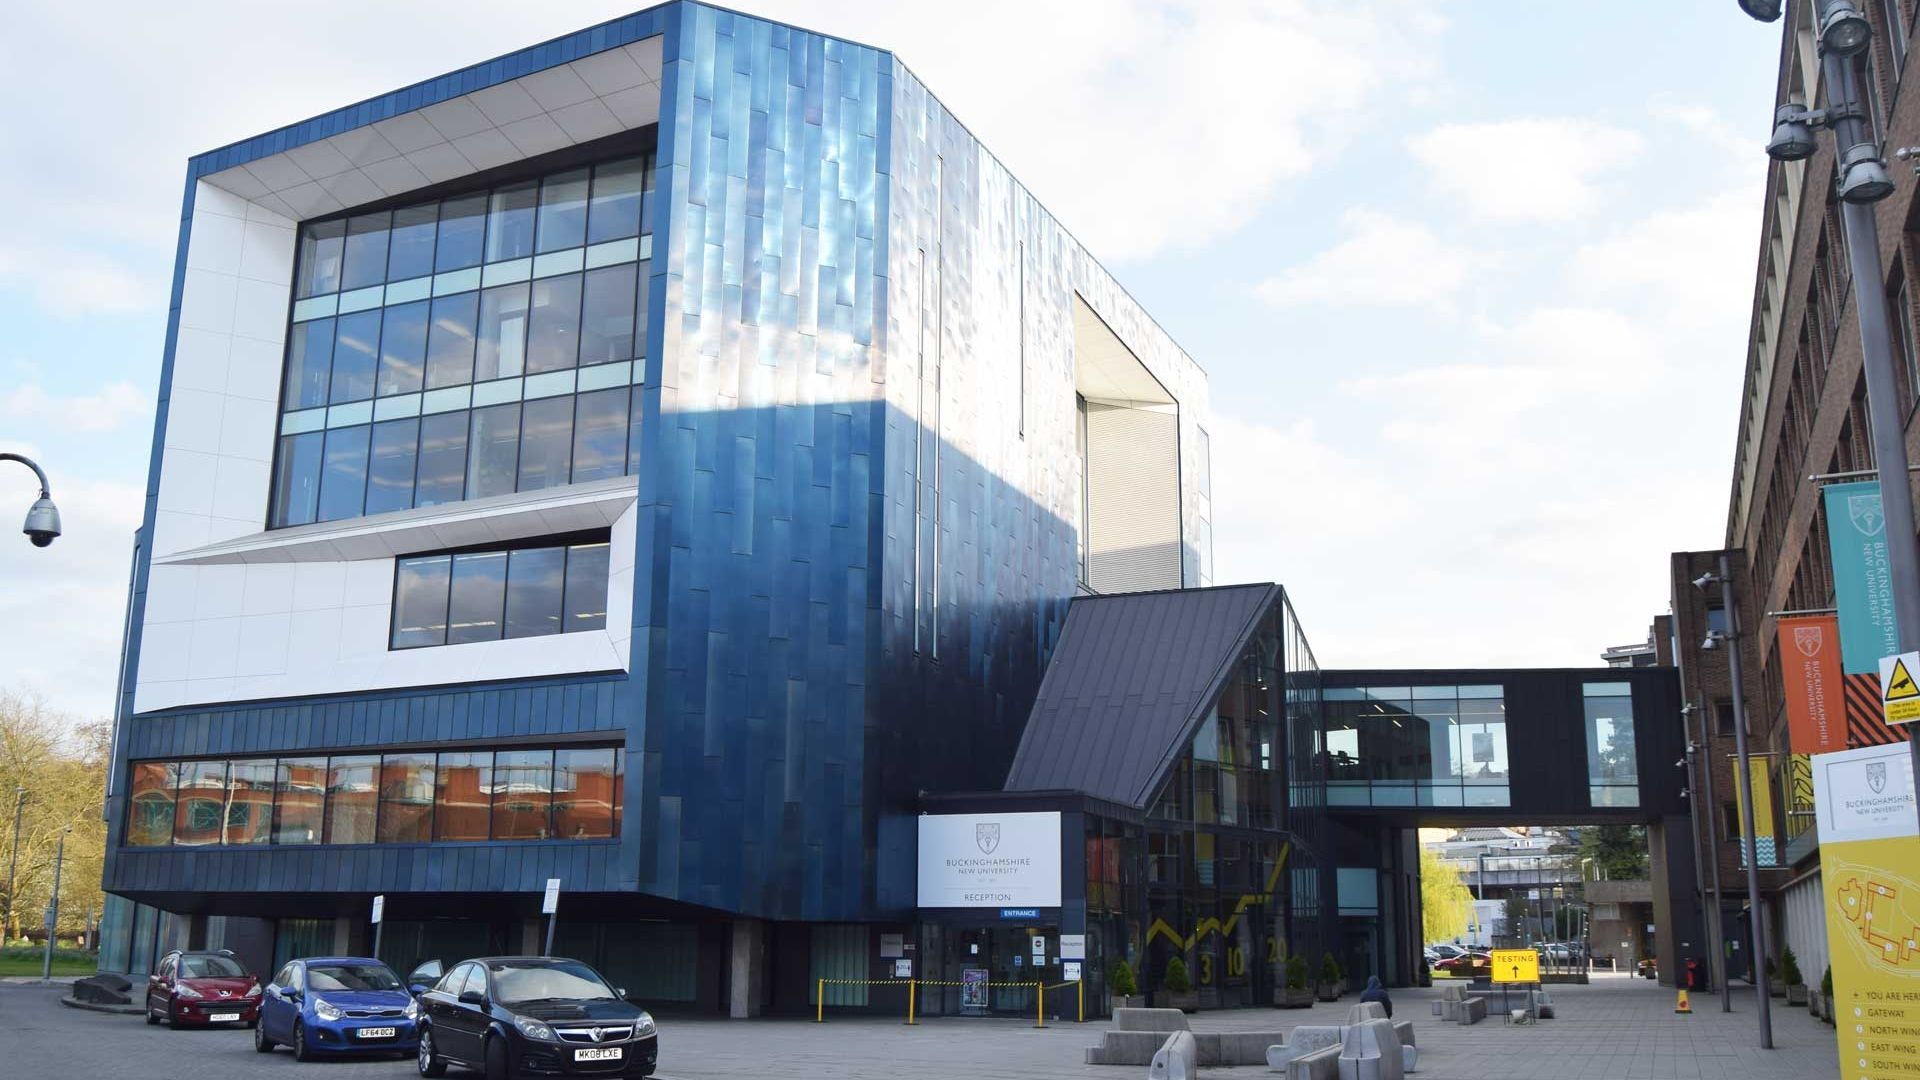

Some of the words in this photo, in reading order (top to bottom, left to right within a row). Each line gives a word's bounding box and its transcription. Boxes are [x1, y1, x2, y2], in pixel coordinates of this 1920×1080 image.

[1863, 543, 1874, 567] NEW
[1865, 569, 1880, 626] UNIVERSITY
[1874, 542, 1897, 654] BUCKINGHAMSHIR
[1804, 661, 1813, 679] NEW
[1807, 680, 1818, 721] UNIVERSITY
[1812, 660, 1829, 745] BUCKINGHAMSHIRE
[1845, 794, 1914, 809] BUCKINGHAMSHIRE
[946, 858, 1031, 867] BUCKINGHAMSHIRE
[978, 867, 1018, 875] UNIVERSITY
[964, 893, 1011, 902] RECEPTION
[1866, 991, 1883, 1000] YOU
[1886, 992, 1901, 1000] ARE
[361, 1029, 379, 1037] LF64
[1870, 1026, 1898, 1035] NORTH
[578, 1050, 601, 1059] MK08
[602, 1049, 619, 1058] LXE
[1871, 1043, 1890, 1052] EAST
[1893, 1045, 1917, 1054] WING
[1872, 1060, 1900, 1070] SOUTH
[1903, 1062, 1920, 1072] WIN
